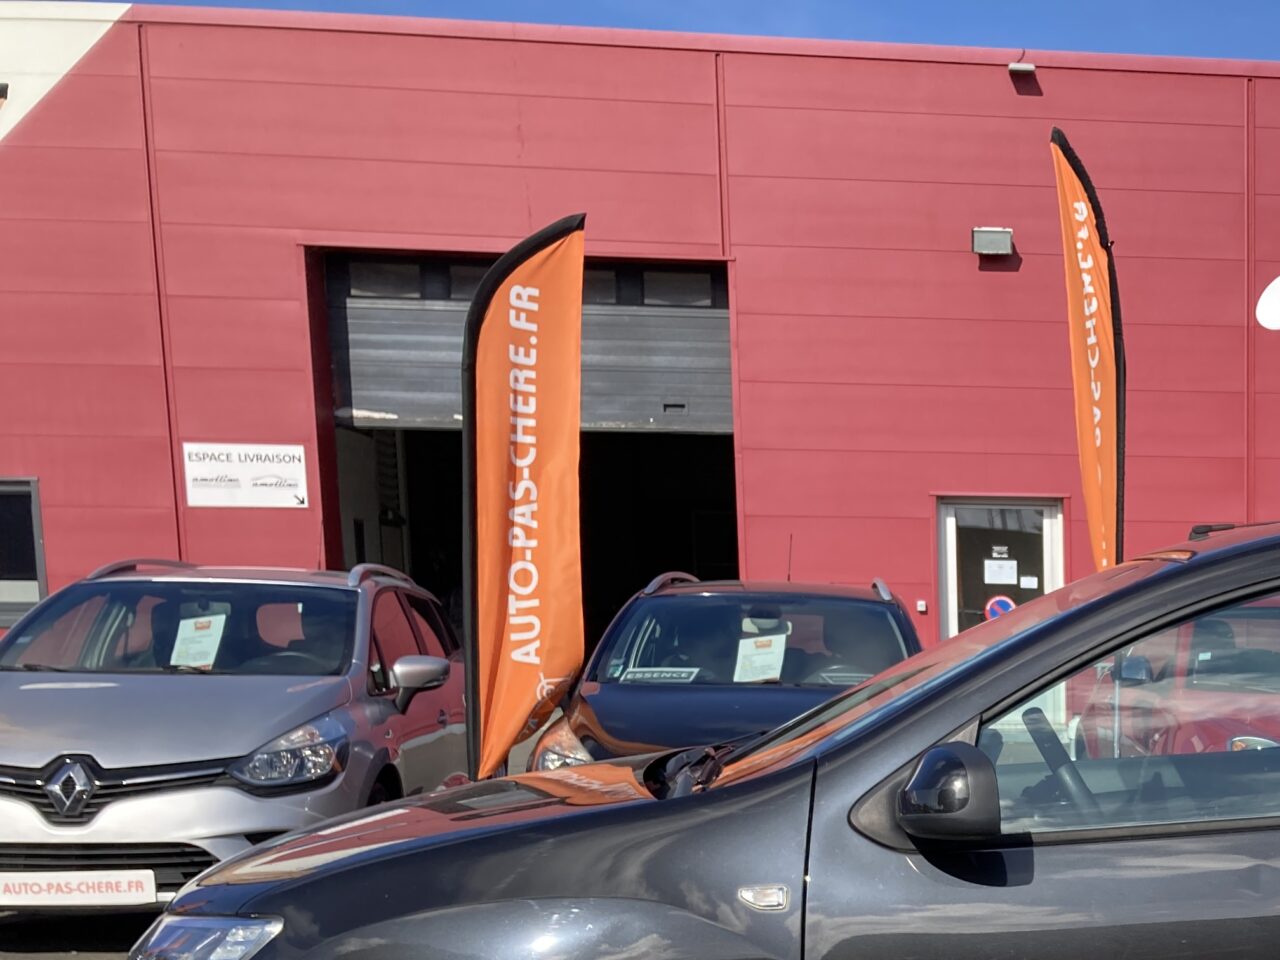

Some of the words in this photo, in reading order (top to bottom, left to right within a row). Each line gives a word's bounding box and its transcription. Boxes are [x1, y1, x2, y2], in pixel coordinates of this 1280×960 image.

[187, 451, 233, 463] ESPACE
[238, 453, 302, 464] LIVRAISON
[508, 284, 541, 665] AUTO-PAS-CHERE.FR
[626, 671, 690, 680] ESSENCE
[2, 879, 145, 896] AUTO-PAS-CHERE.FR
